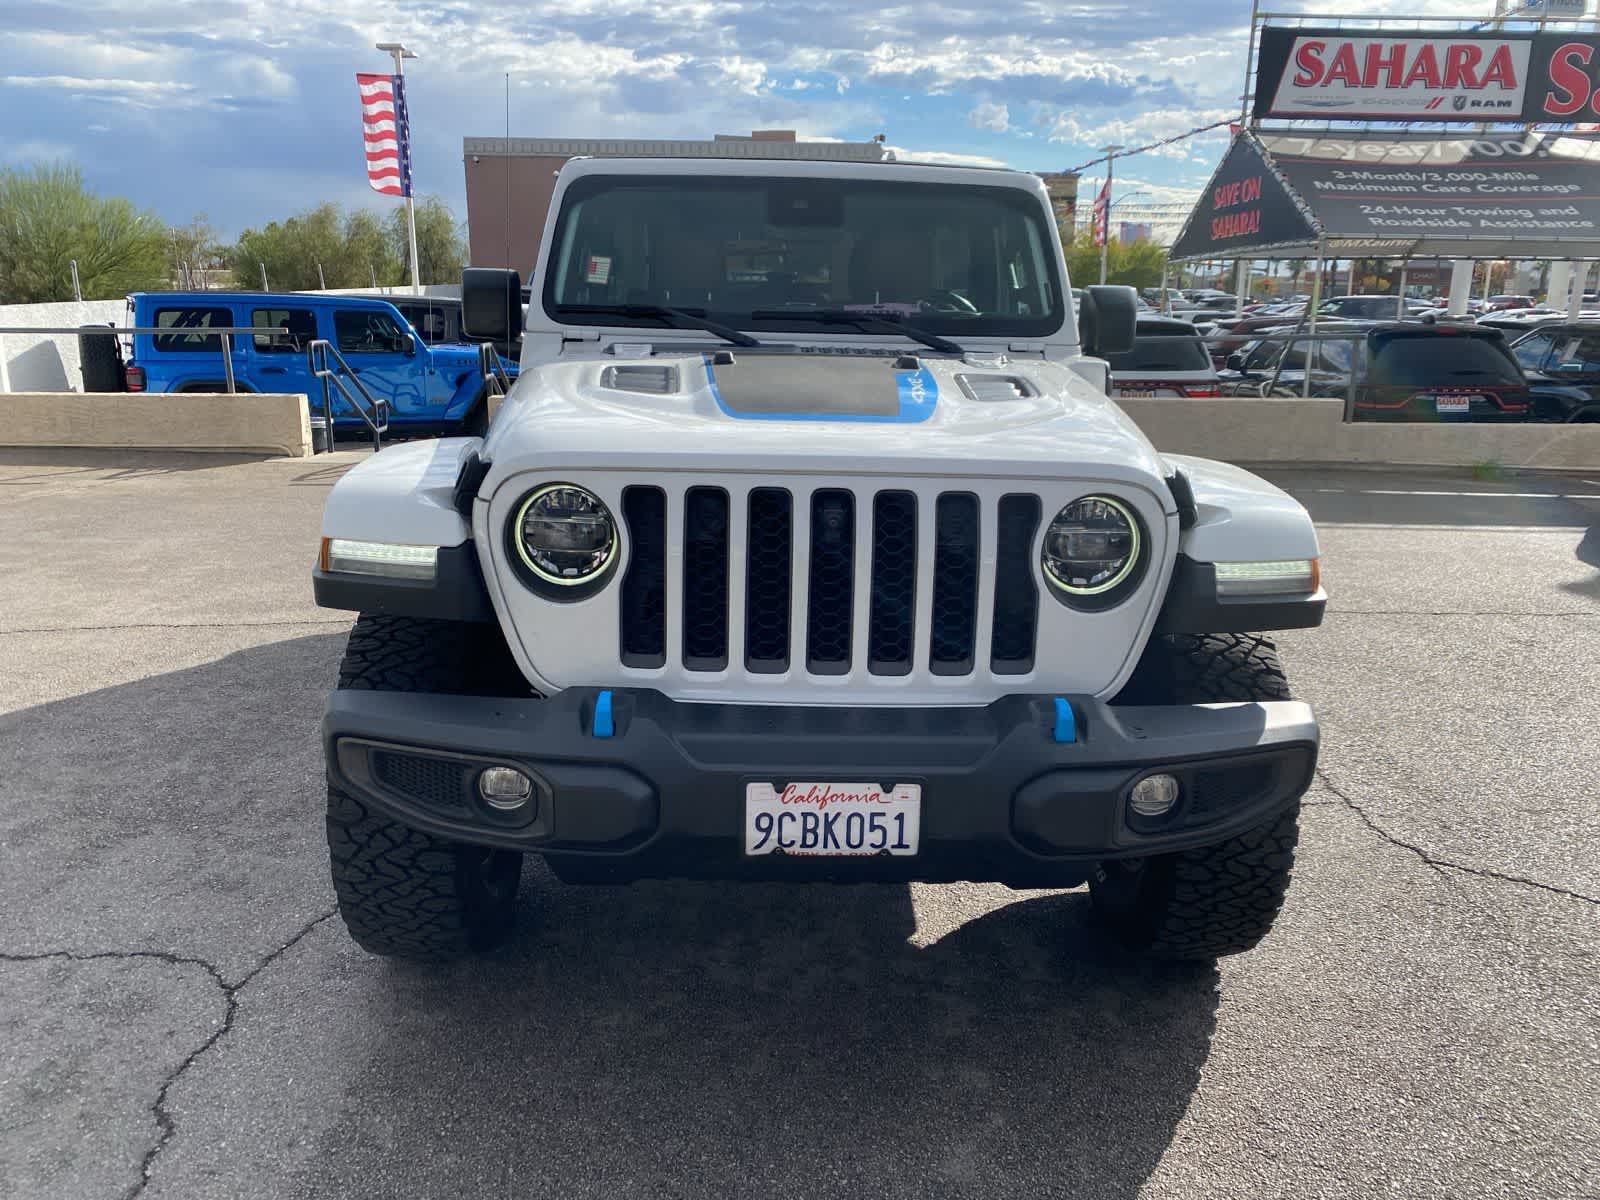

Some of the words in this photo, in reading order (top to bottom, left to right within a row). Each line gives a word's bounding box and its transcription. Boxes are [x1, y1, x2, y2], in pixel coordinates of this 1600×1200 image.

[1293, 41, 1518, 89] SAHARA
[1543, 42, 1600, 117] S
[1470, 99, 1513, 108] RAM
[1214, 183, 1241, 209] SAVE
[1241, 176, 1262, 202] ON
[1313, 180, 1418, 193] Maximum
[1421, 183, 1472, 193] Care
[1476, 183, 1581, 193] Coverage
[1211, 210, 1261, 240] SAHARA!
[1359, 204, 1447, 215] 24-Hour
[1450, 206, 1535, 218] Towing
[1538, 205, 1580, 216] and
[1368, 217, 1472, 228] Roadside
[1479, 218, 1595, 229] Assistance
[781, 784, 892, 810] California
[753, 811, 911, 851] 9CBK051
